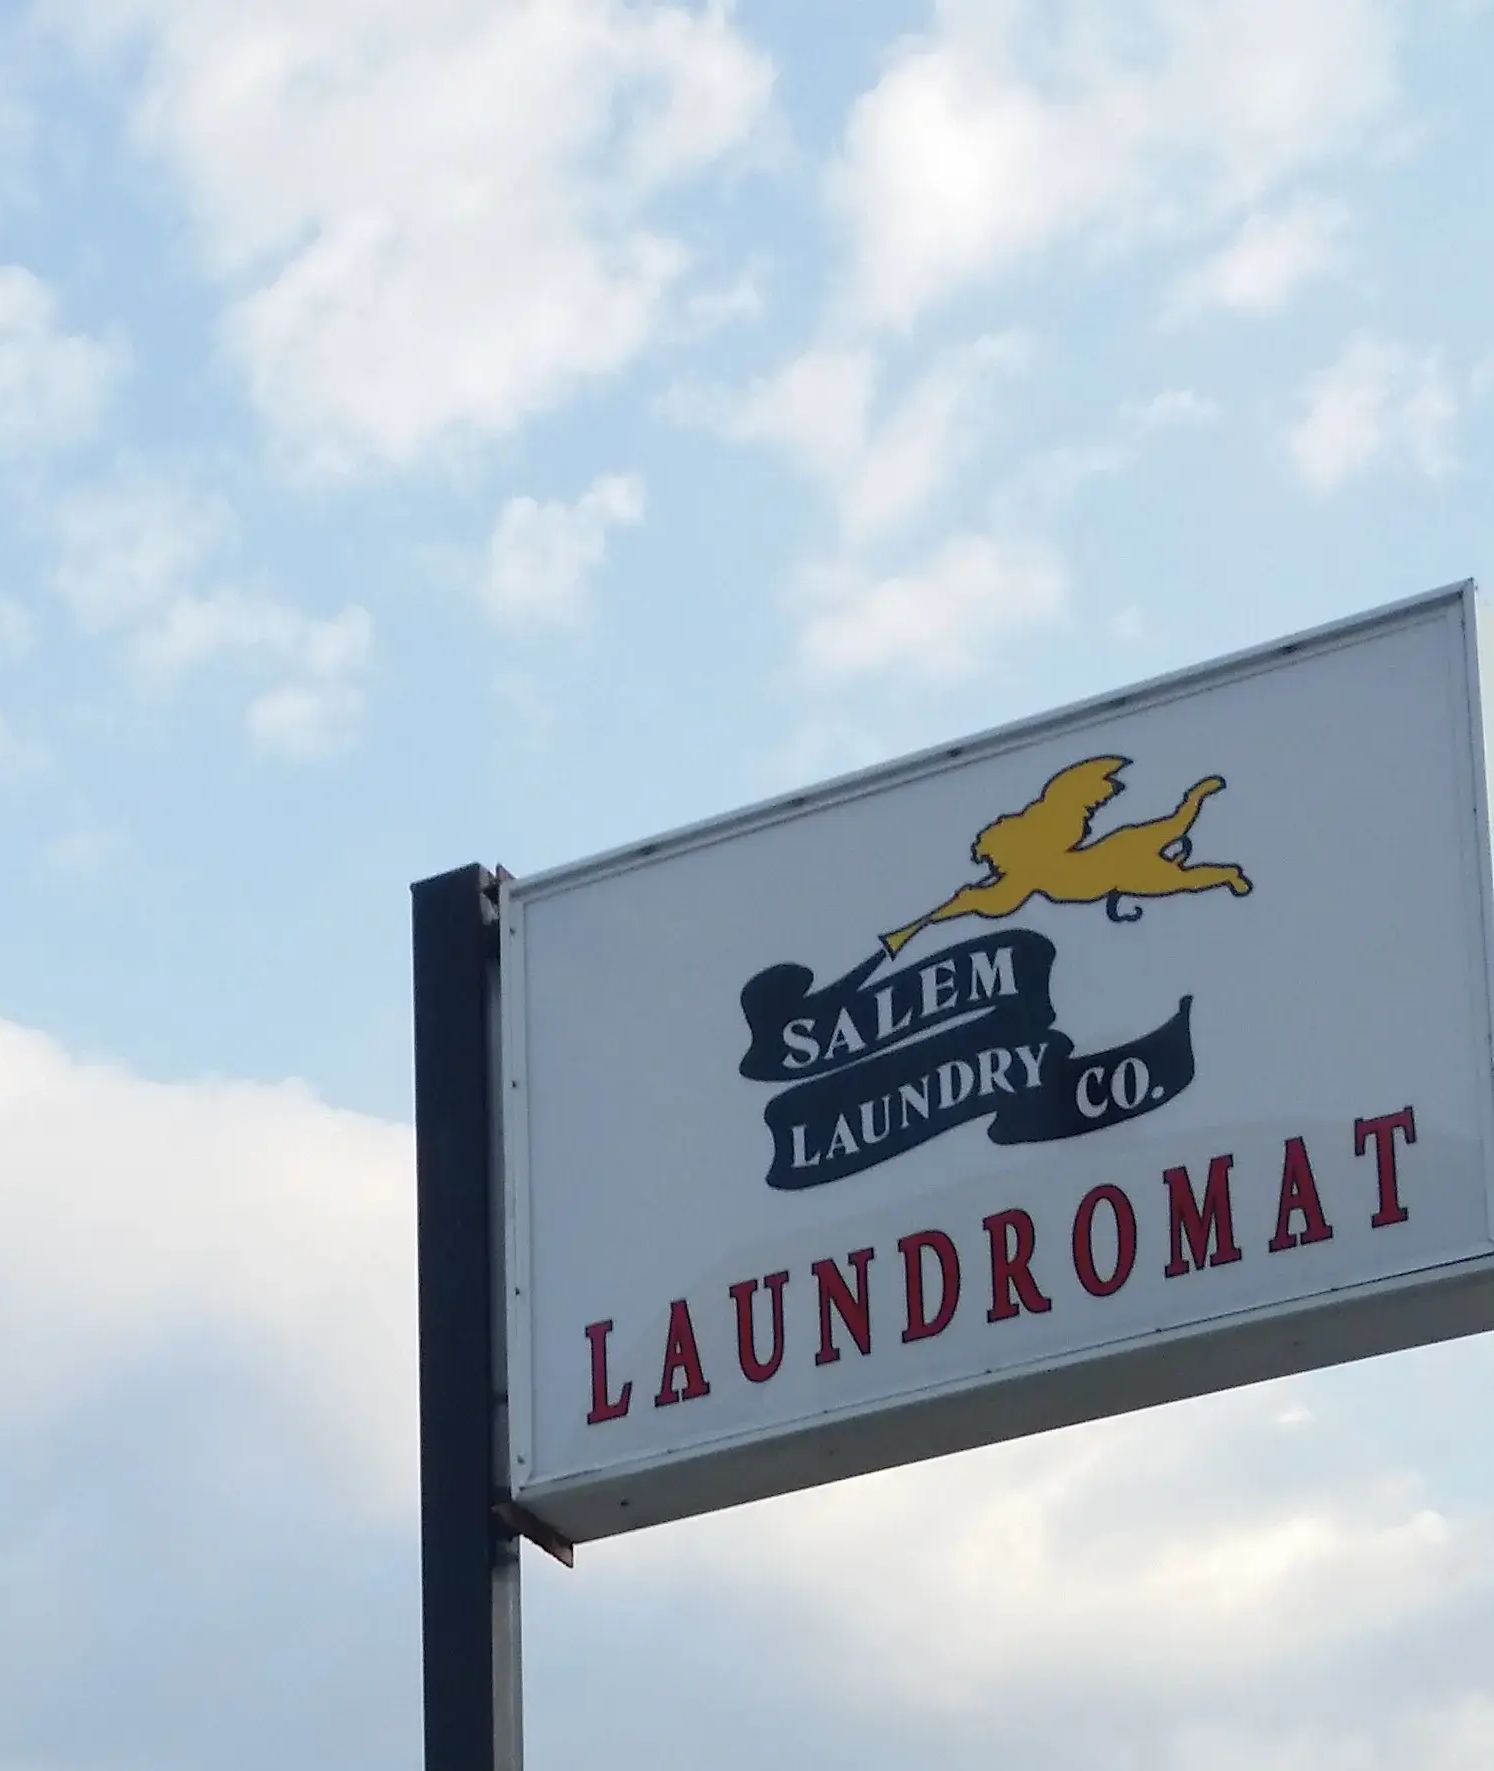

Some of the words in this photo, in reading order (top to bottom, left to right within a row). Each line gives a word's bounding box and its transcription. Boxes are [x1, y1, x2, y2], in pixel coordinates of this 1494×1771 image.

[782, 947, 1018, 1068] SALEM
[790, 1043, 1048, 1169] LAUNDRY
[1075, 1056, 1165, 1118] CO.
[584, 1106, 1417, 1426] LAUNDROMAT
